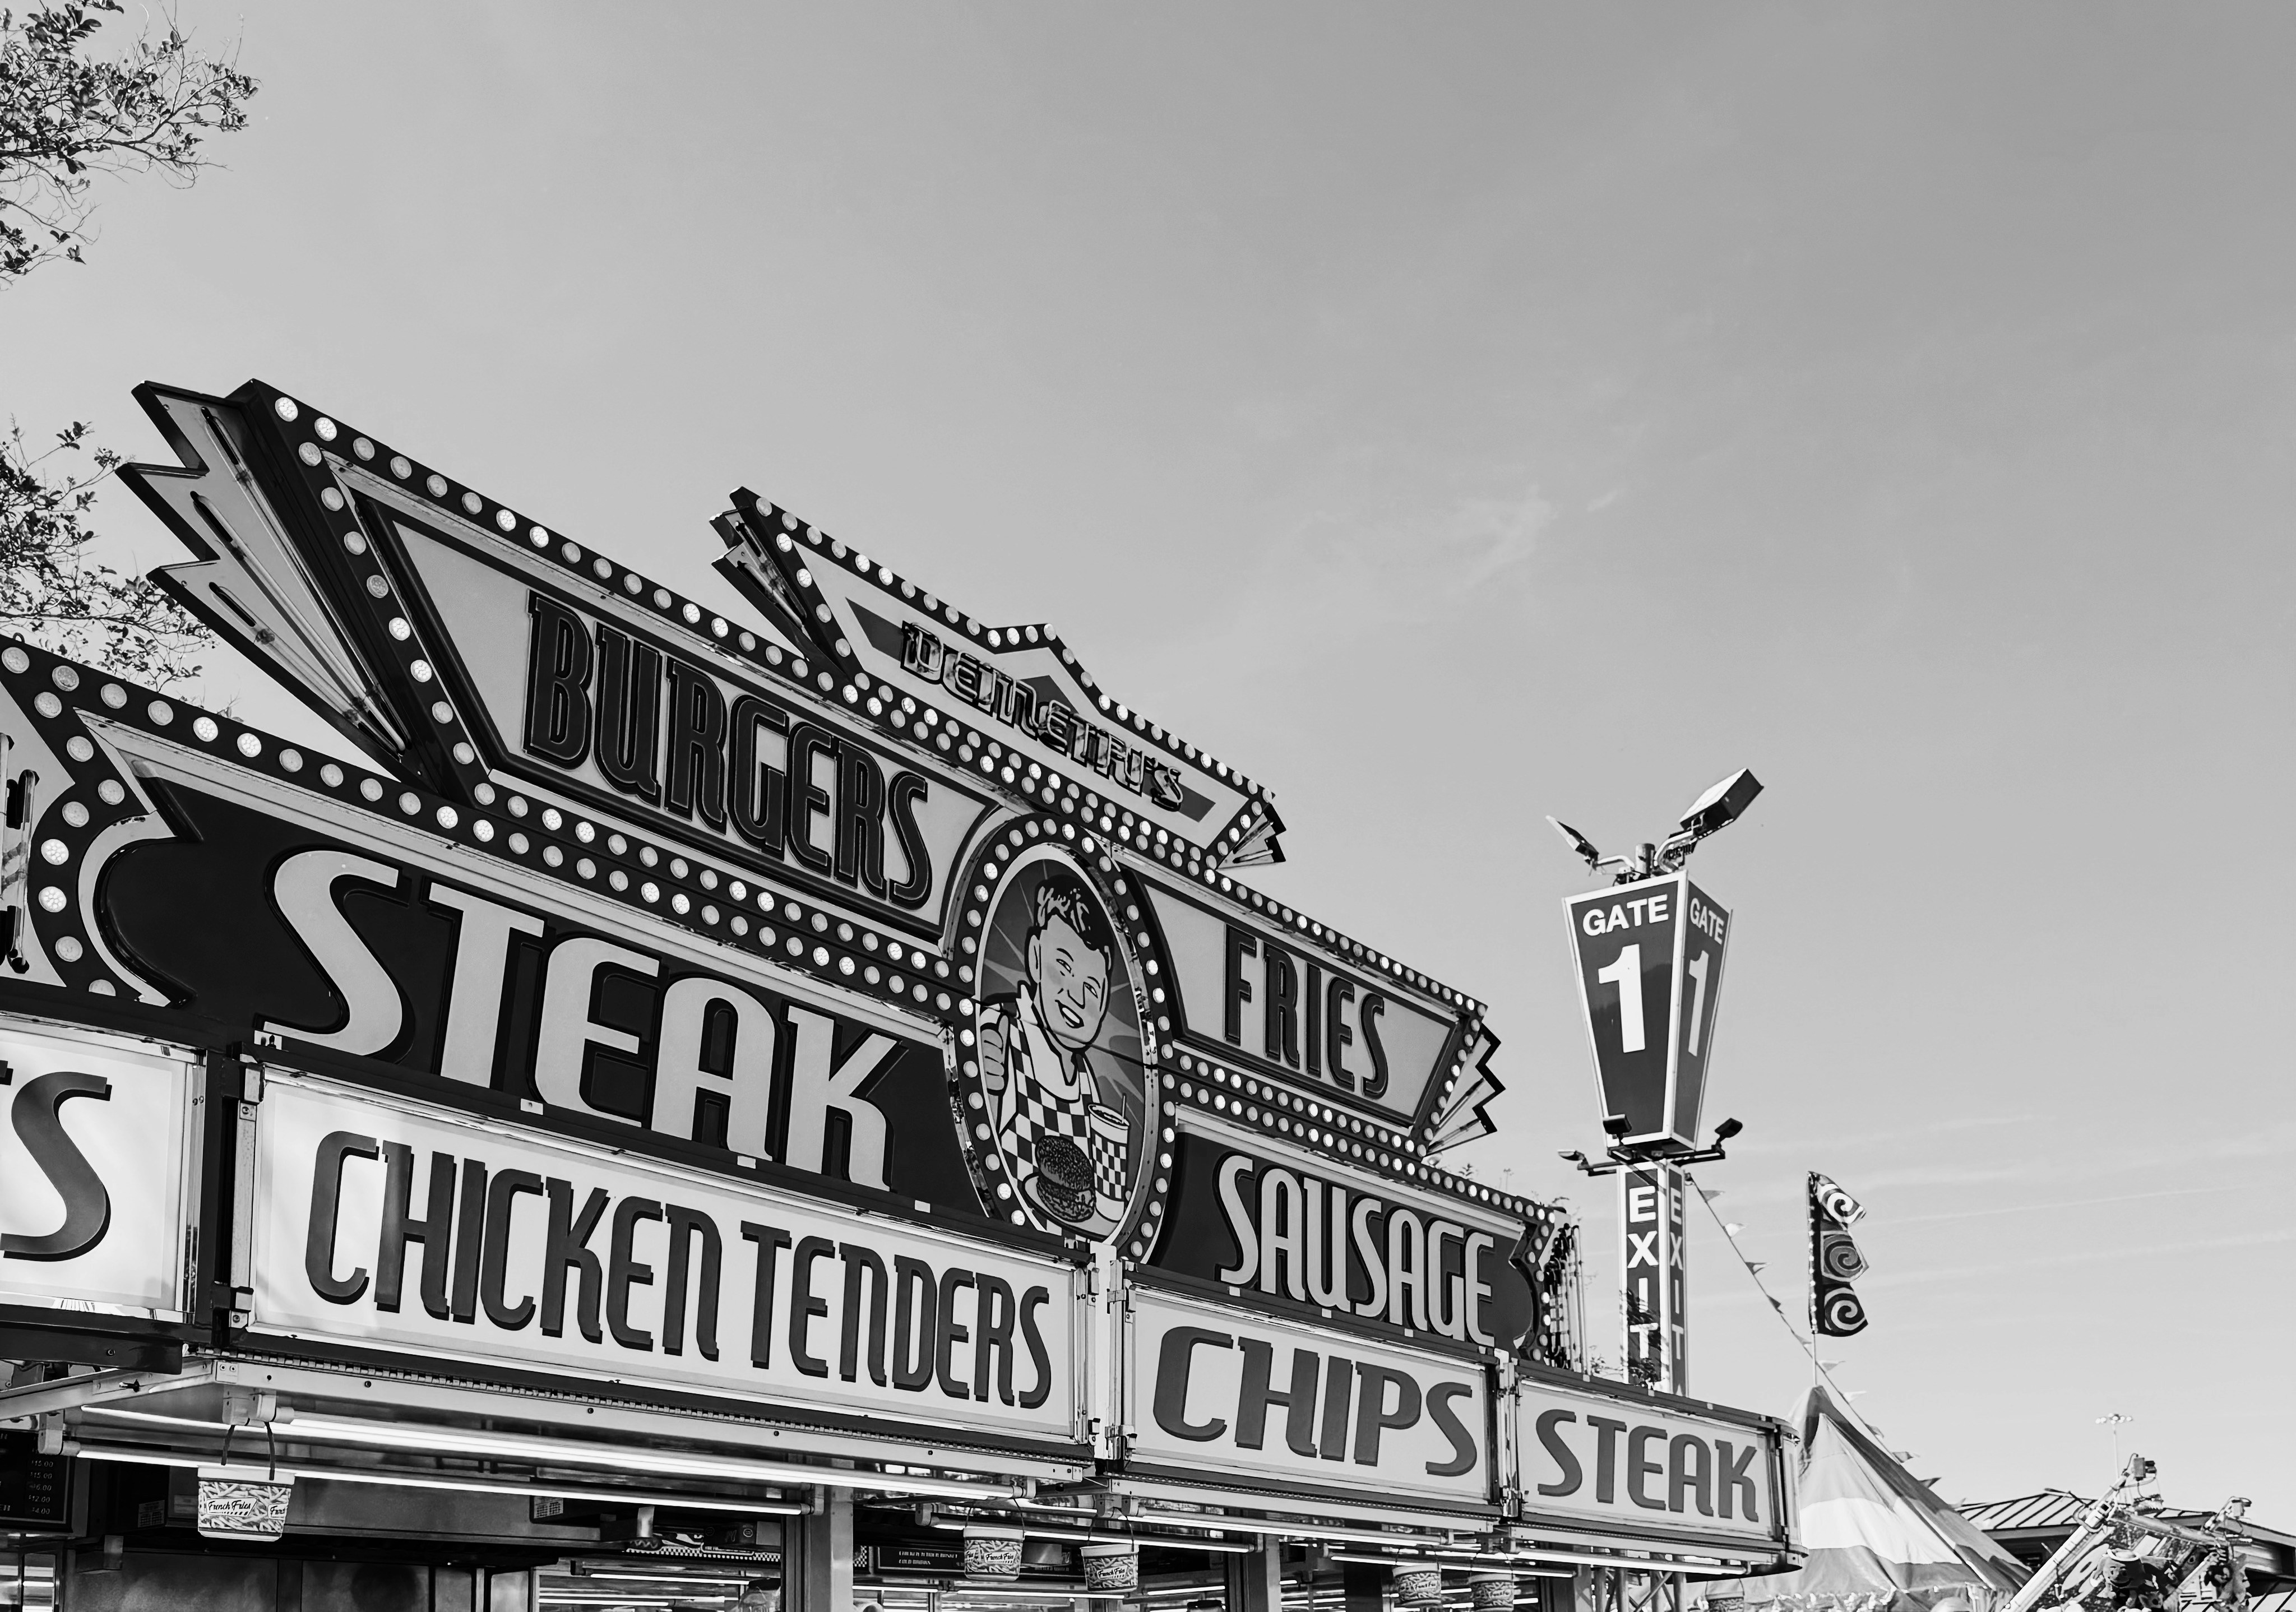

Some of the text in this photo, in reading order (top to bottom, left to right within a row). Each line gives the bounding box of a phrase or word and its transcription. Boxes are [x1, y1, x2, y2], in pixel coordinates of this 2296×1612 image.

[523, 588, 933, 910] BURGERS
[1582, 893, 1669, 936] GATE
[1598, 943, 1646, 1054] 1
[1689, 897, 1725, 945] GATE
[258, 846, 904, 1192] STEAK
[1224, 924, 1389, 1099] FRIES
[1688, 950, 1710, 1057] 1
[304, 1131, 1052, 1409] CHICKEN TENDERS
[1215, 1154, 1496, 1346] SAUSAGE
[1627, 1185, 1659, 1360] EXIT
[1670, 1187, 1684, 1360] EXIT
[1153, 1326, 1478, 1477] CHIPS
[1535, 1409, 1759, 1523] STEAK
